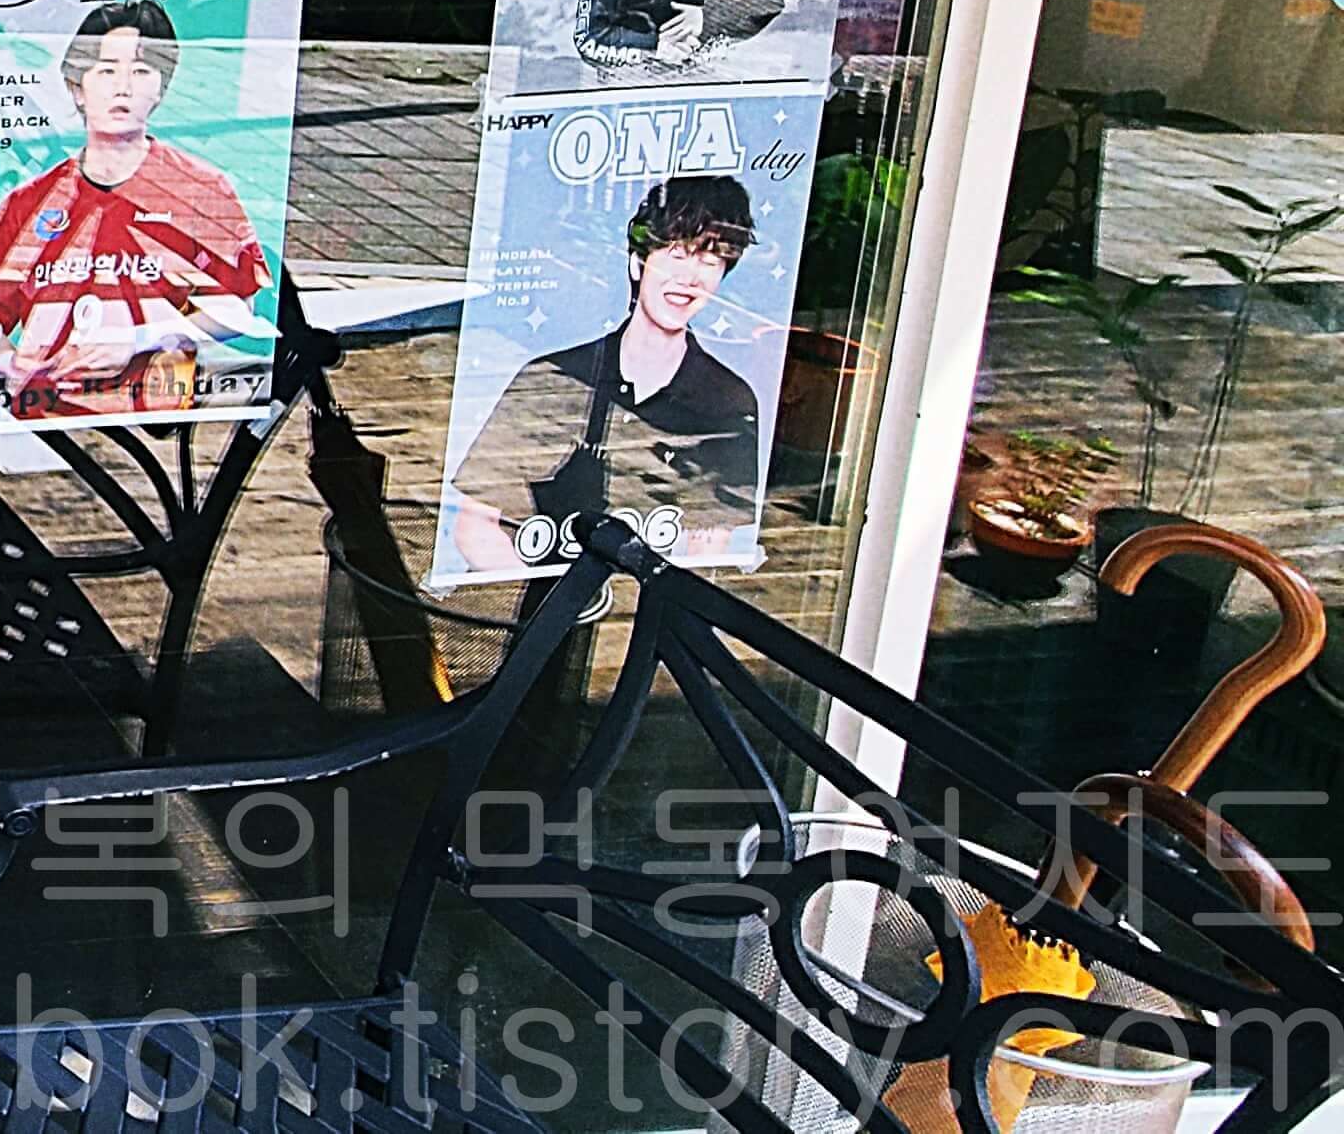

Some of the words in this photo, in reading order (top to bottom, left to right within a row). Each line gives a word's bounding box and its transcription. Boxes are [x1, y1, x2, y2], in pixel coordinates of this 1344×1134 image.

[548, 102, 747, 186] ONA
[750, 138, 808, 182] day
[34, 252, 163, 290] 인천광역시청
[489, 265, 542, 277] LAYER
